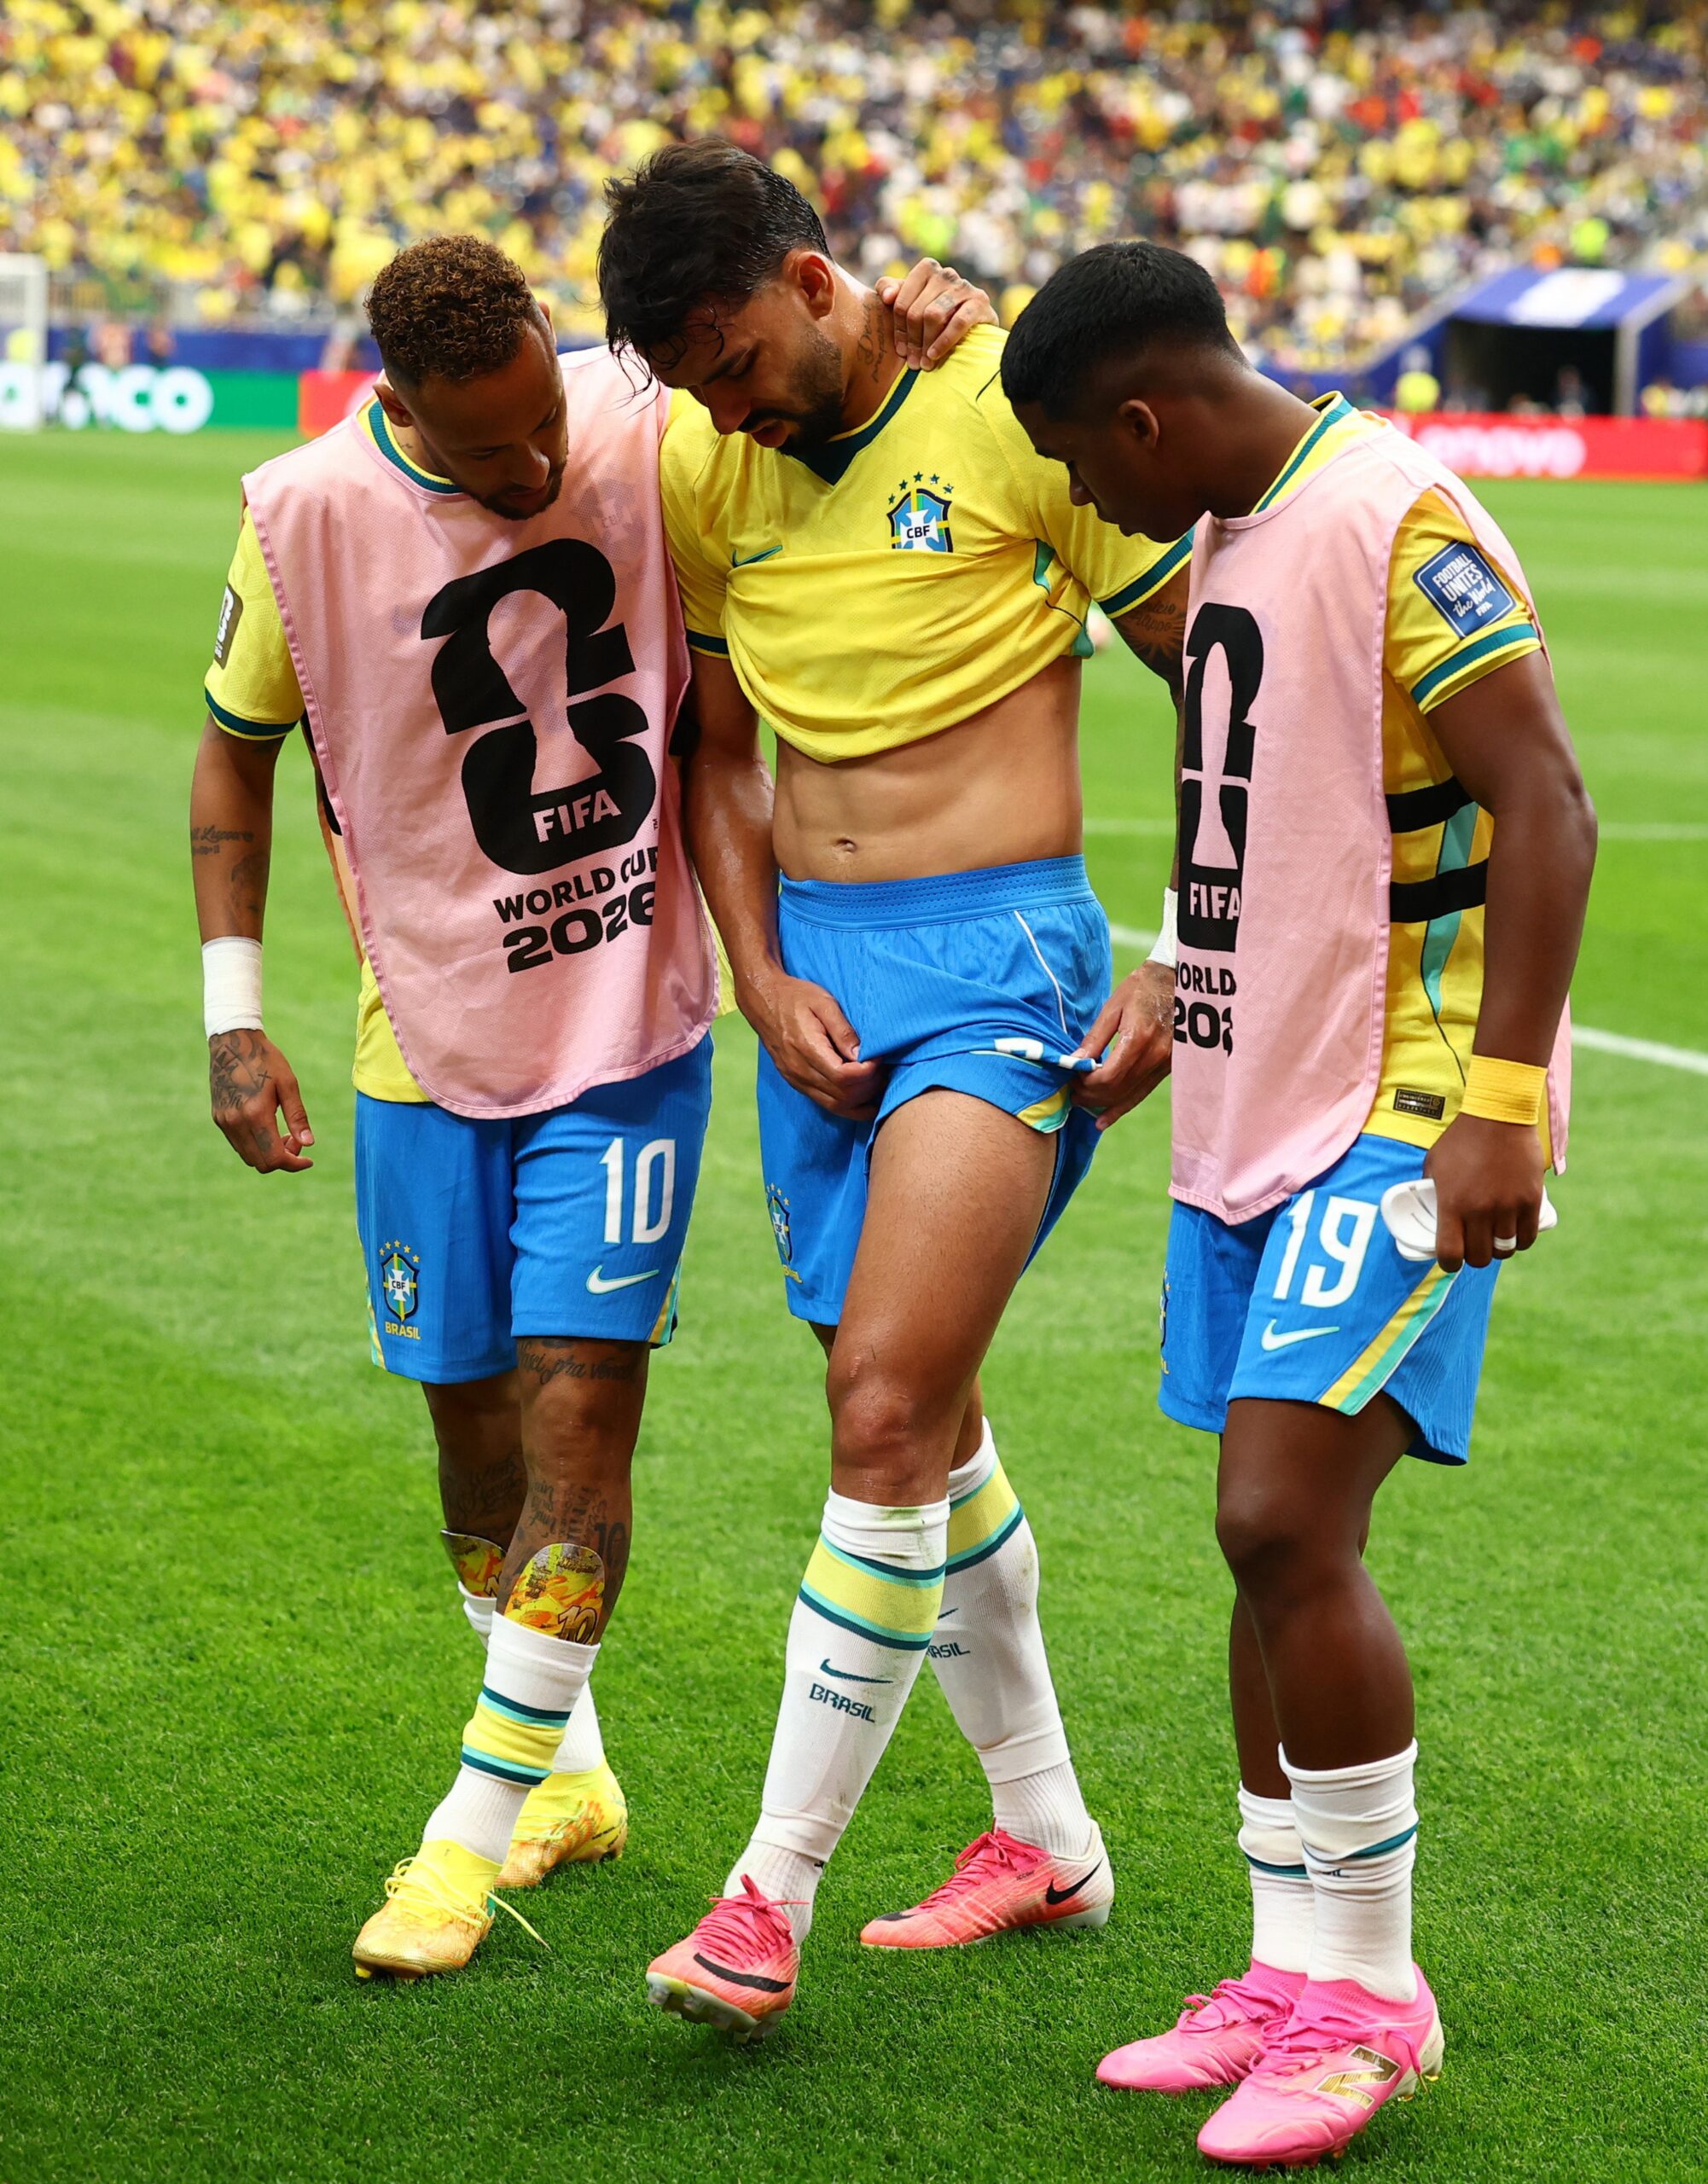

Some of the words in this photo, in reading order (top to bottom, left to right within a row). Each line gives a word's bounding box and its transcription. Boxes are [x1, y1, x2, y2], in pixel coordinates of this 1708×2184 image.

[1399, 418, 1587, 479] enovo
[907, 525, 930, 538] CBF
[1432, 553, 1473, 589] FOOTBALL
[1441, 563, 1484, 602] UNITES
[1452, 600, 1473, 618] the
[1467, 577, 1496, 605] World
[1475, 601, 1494, 617] FIFA
[532, 789, 622, 843] FIFA
[493, 867, 616, 923] WORLD
[1189, 881, 1240, 921] FIFA
[503, 881, 656, 973] 2026
[1176, 961, 1237, 996] ORLD
[599, 1137, 676, 1244] 10
[1273, 1190, 1379, 1309] 19
[392, 1280, 406, 1290] CBF
[385, 1321, 421, 1340] BRASIL
[557, 1605, 598, 1645] 10
[927, 1641, 971, 1658] ASIL
[809, 1683, 875, 1723] BRASIL
